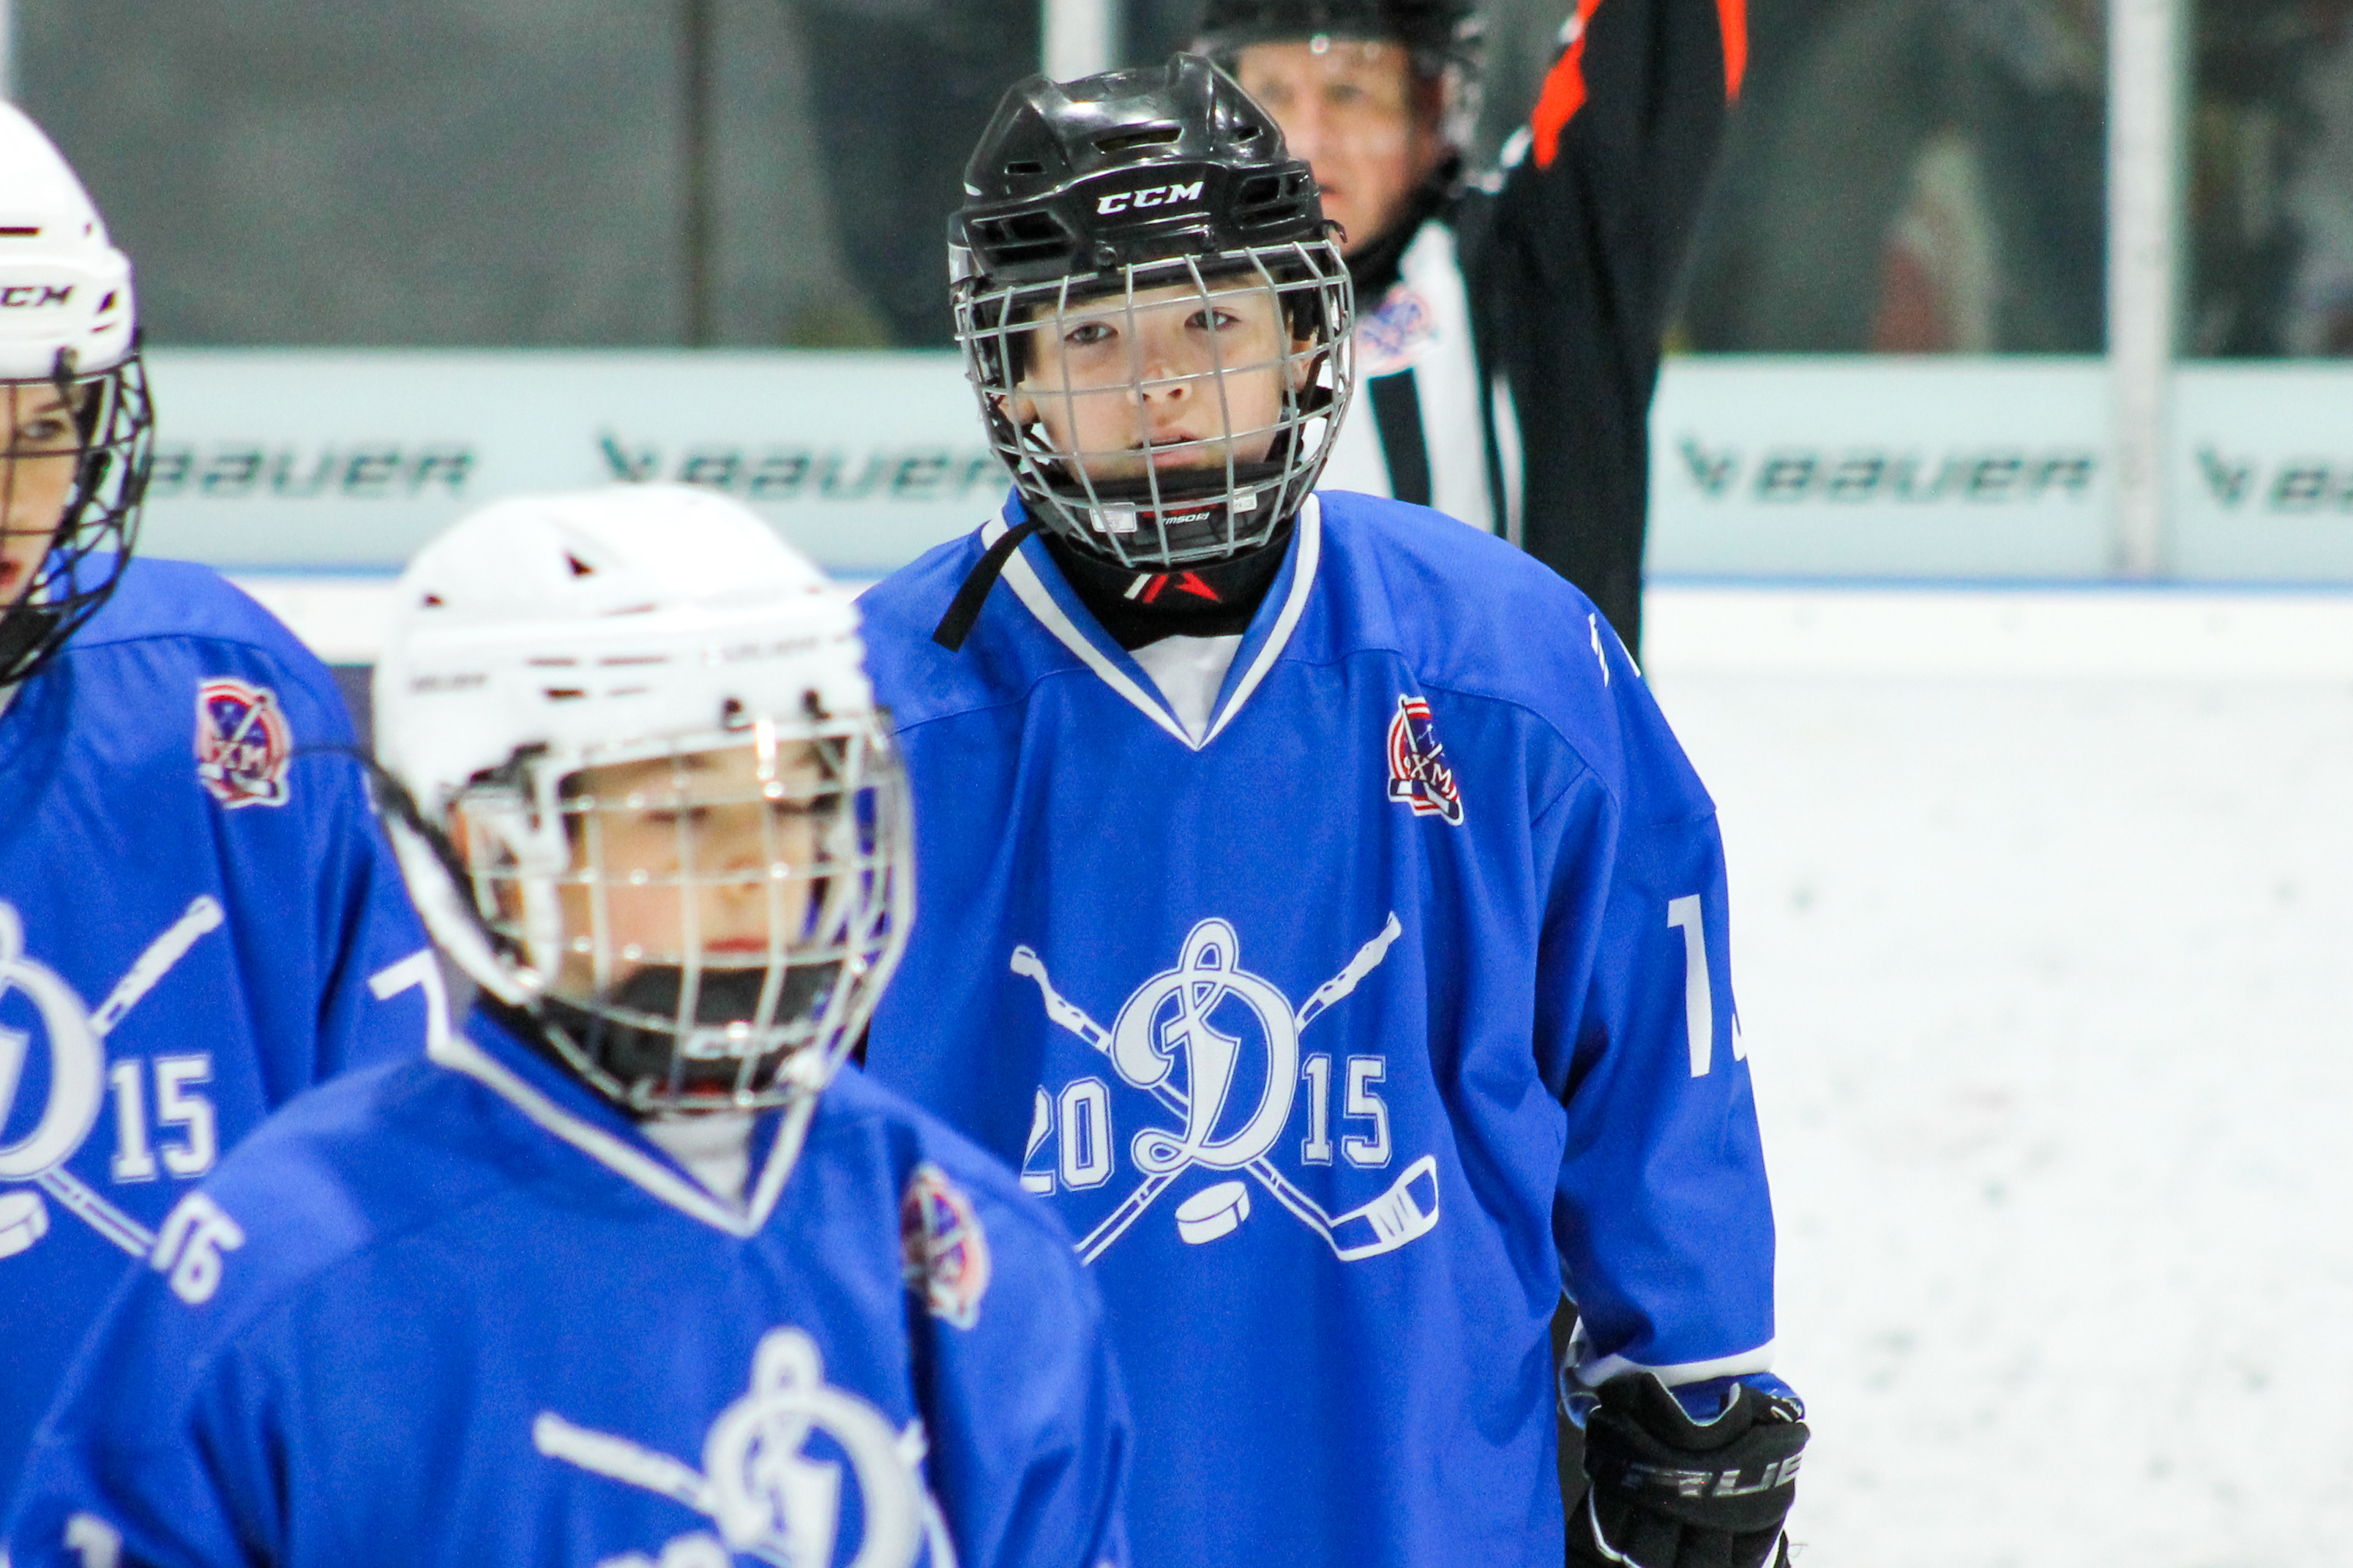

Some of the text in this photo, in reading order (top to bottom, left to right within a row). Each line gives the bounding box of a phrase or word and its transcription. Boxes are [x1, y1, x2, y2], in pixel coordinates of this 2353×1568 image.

[1096, 181, 1205, 215] CCM
[1754, 451, 2095, 502] BAUER
[110, 1053, 215, 1182] 15
[1301, 1052, 1392, 1169] 15
